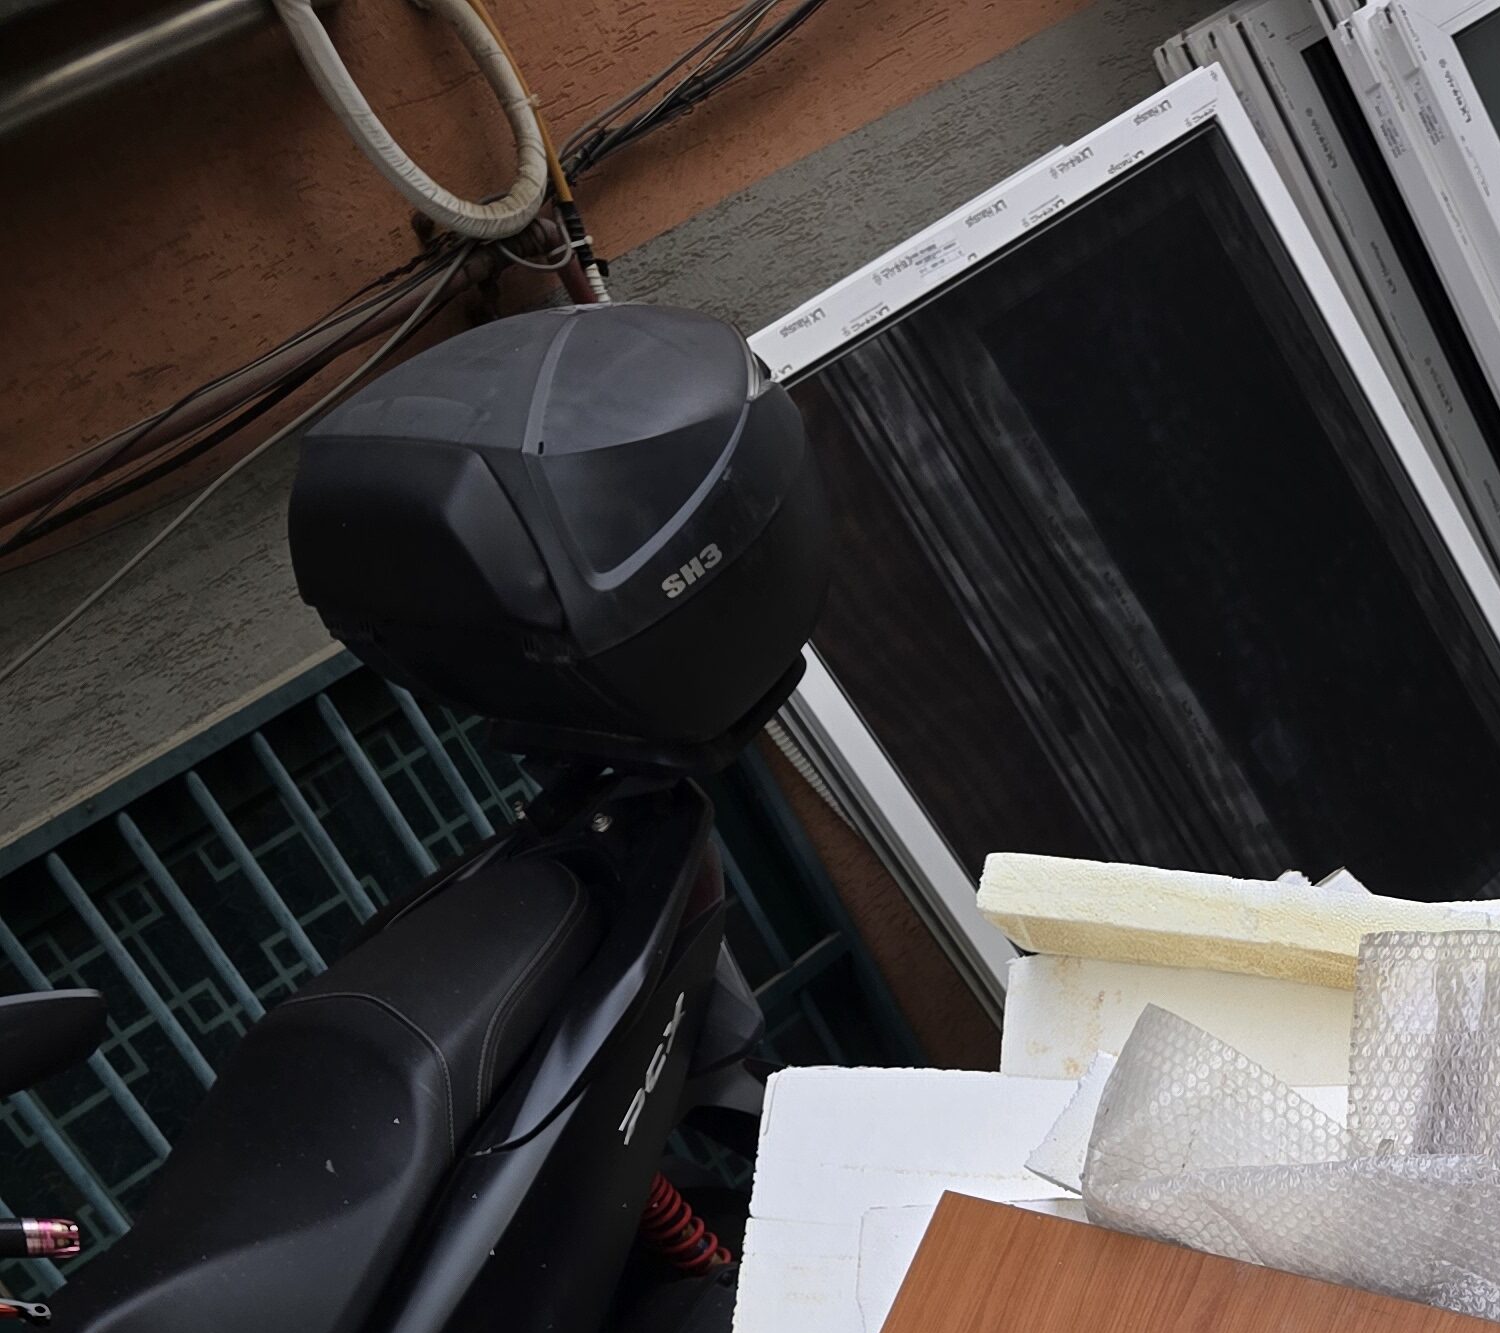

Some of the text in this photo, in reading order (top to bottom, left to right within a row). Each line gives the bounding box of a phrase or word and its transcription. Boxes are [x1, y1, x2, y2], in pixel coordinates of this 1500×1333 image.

[808, 307, 825, 323] LX
[661, 543, 723, 599] SH3
[618, 991, 685, 1146] PCX
